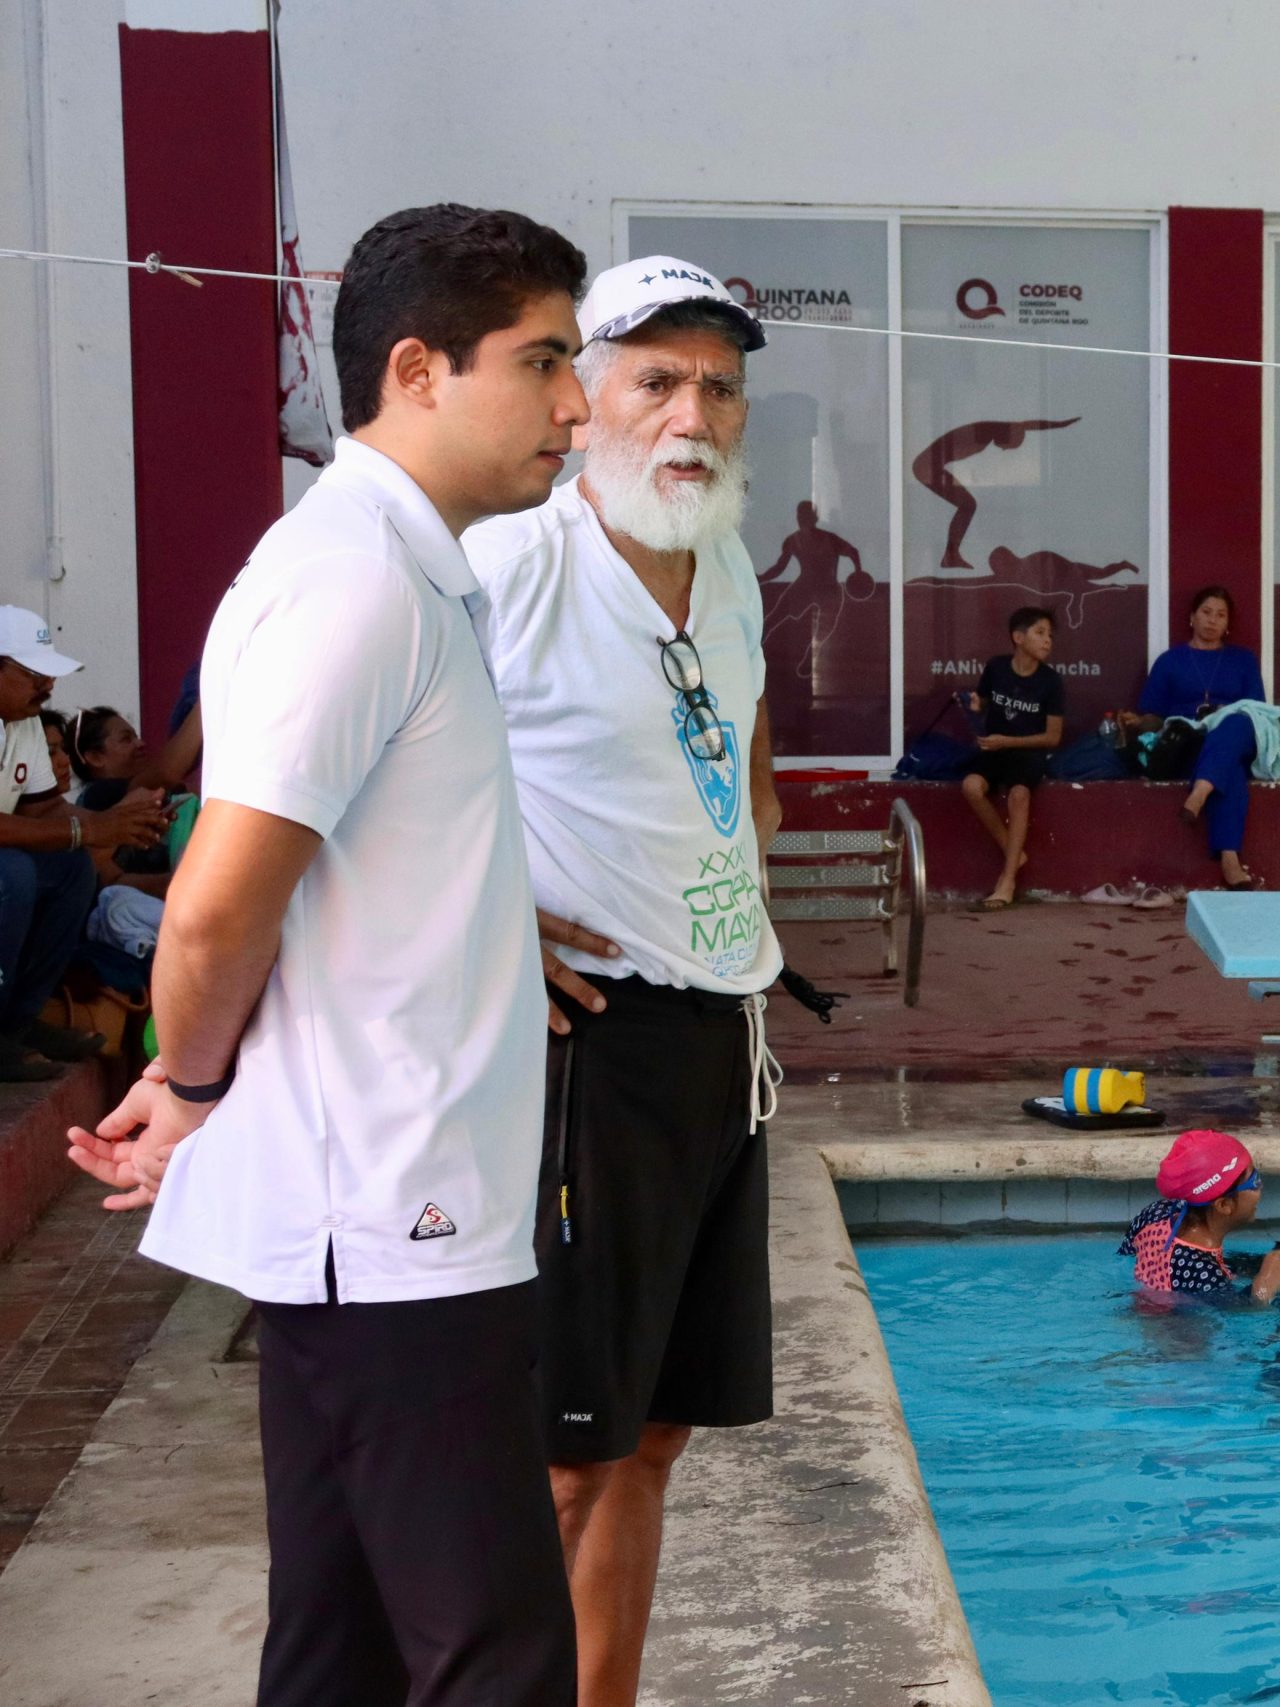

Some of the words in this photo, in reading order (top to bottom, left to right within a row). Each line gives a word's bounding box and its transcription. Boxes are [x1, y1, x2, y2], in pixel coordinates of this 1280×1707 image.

[723, 277, 852, 309] QUINTANA
[1019, 284, 1083, 301] CODEQ
[756, 304, 802, 321] ROO
[682, 869, 759, 916] COPA
[690, 903, 760, 953] MAYA
[1192, 1173, 1222, 1195] arena
